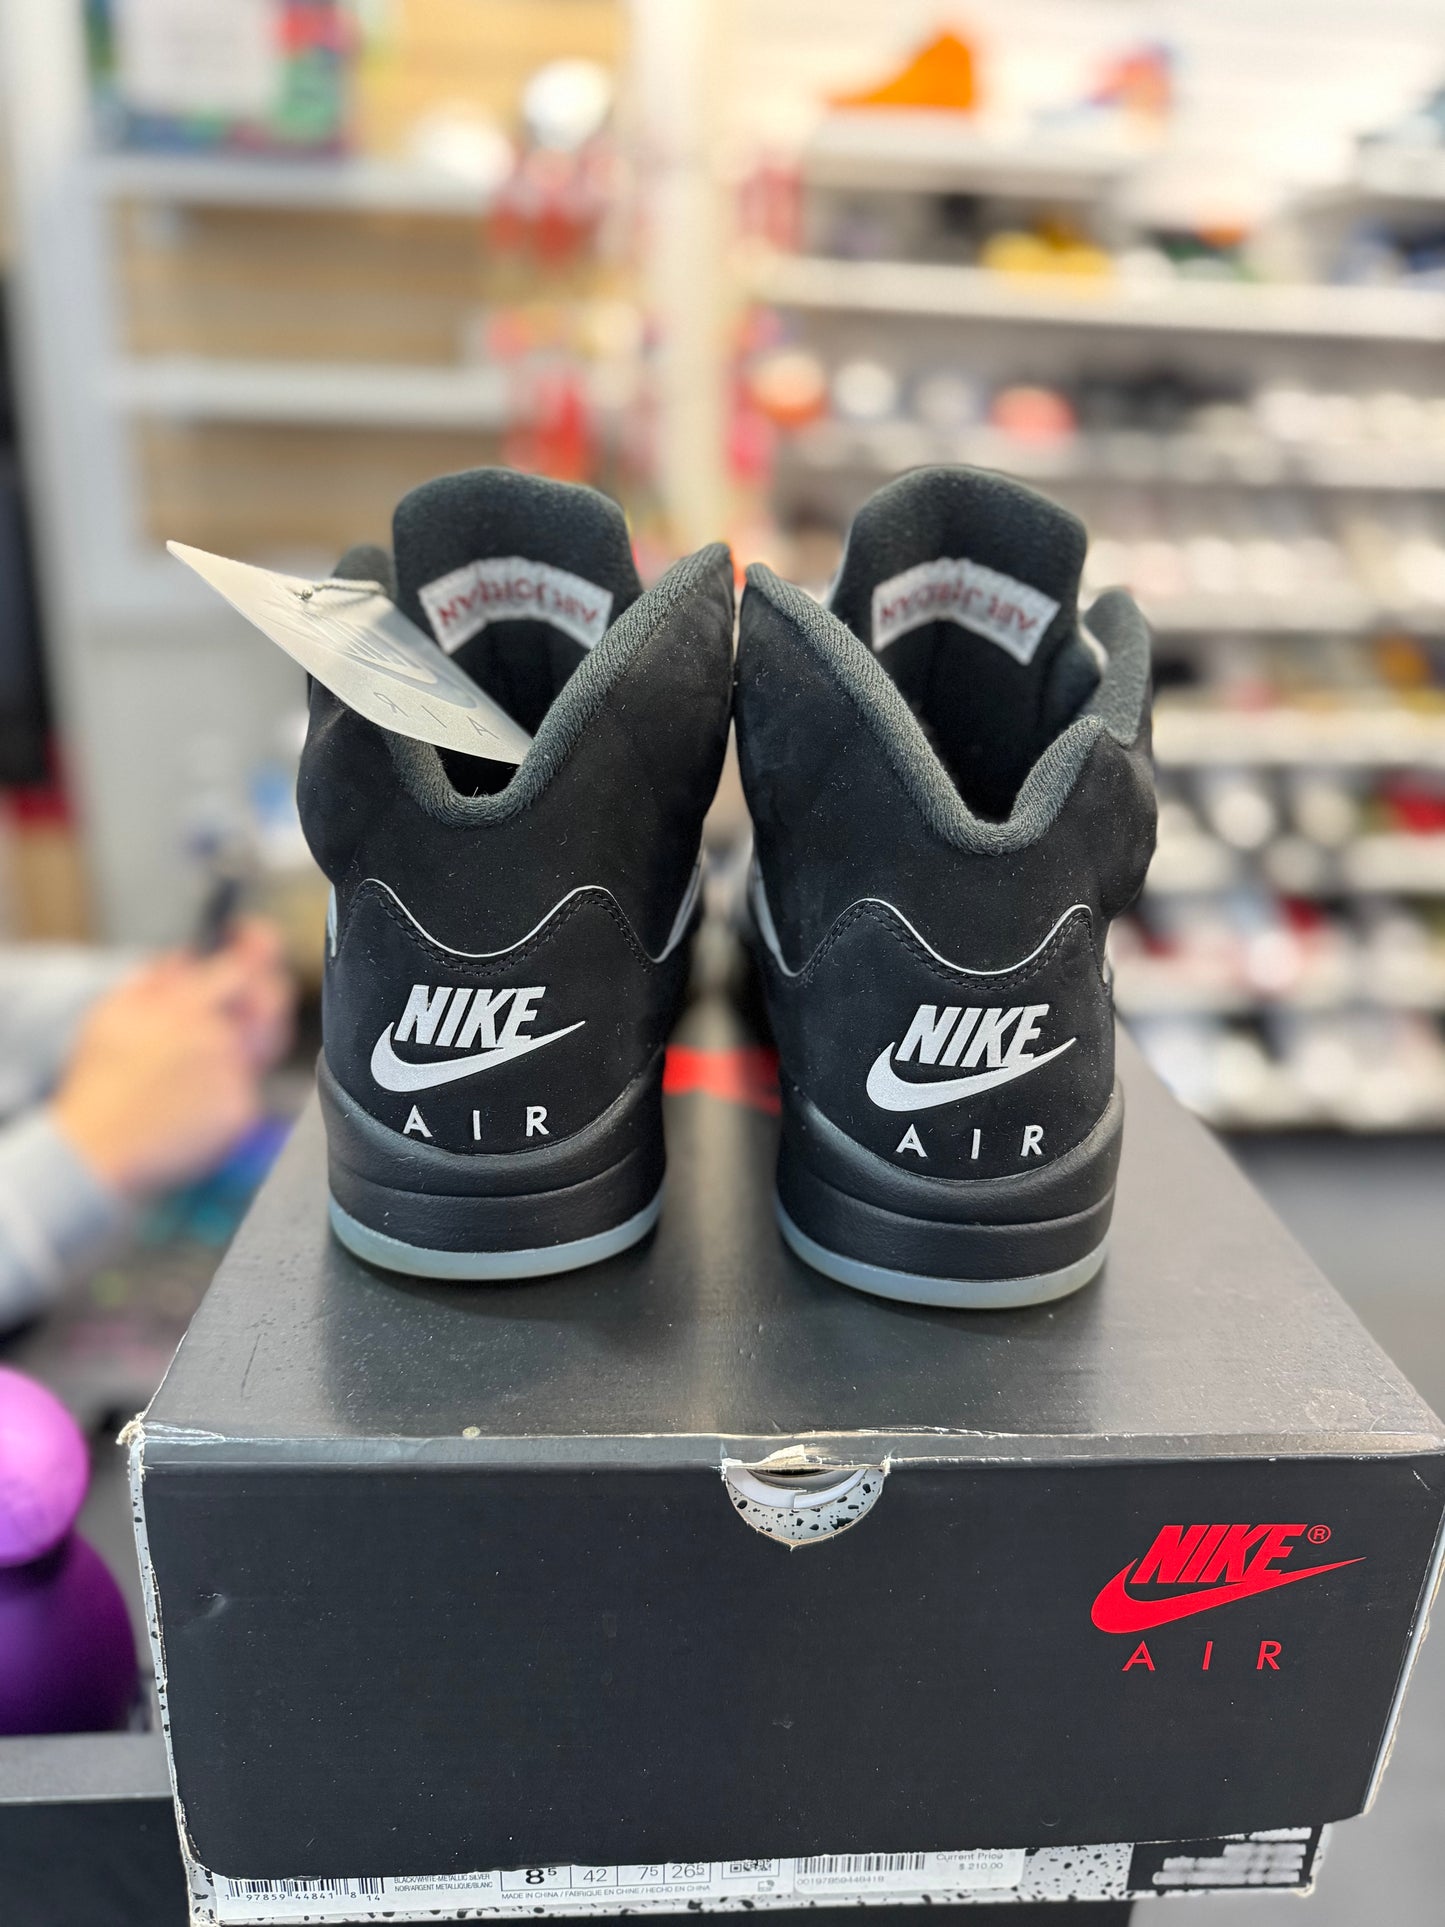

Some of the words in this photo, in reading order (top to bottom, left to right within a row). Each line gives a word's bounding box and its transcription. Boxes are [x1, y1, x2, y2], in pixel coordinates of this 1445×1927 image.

[393, 984, 546, 1049] NIKE
[894, 1003, 1050, 1068] NIKE
[402, 1104, 550, 1141] AIR
[895, 1123, 1044, 1160] AIR
[1122, 1640, 1283, 1672] AIR
[469, 1873, 490, 1881] SILVER
[583, 1868, 607, 1883] 42
[246, 1893, 286, 1901] 97859
[502, 1892, 524, 1900] MADE
[535, 1891, 558, 1899] CHINA
[565, 1889, 602, 1897] FABRIQUE
[604, 1888, 614, 1896] EN
[616, 1887, 640, 1895] CHINE
